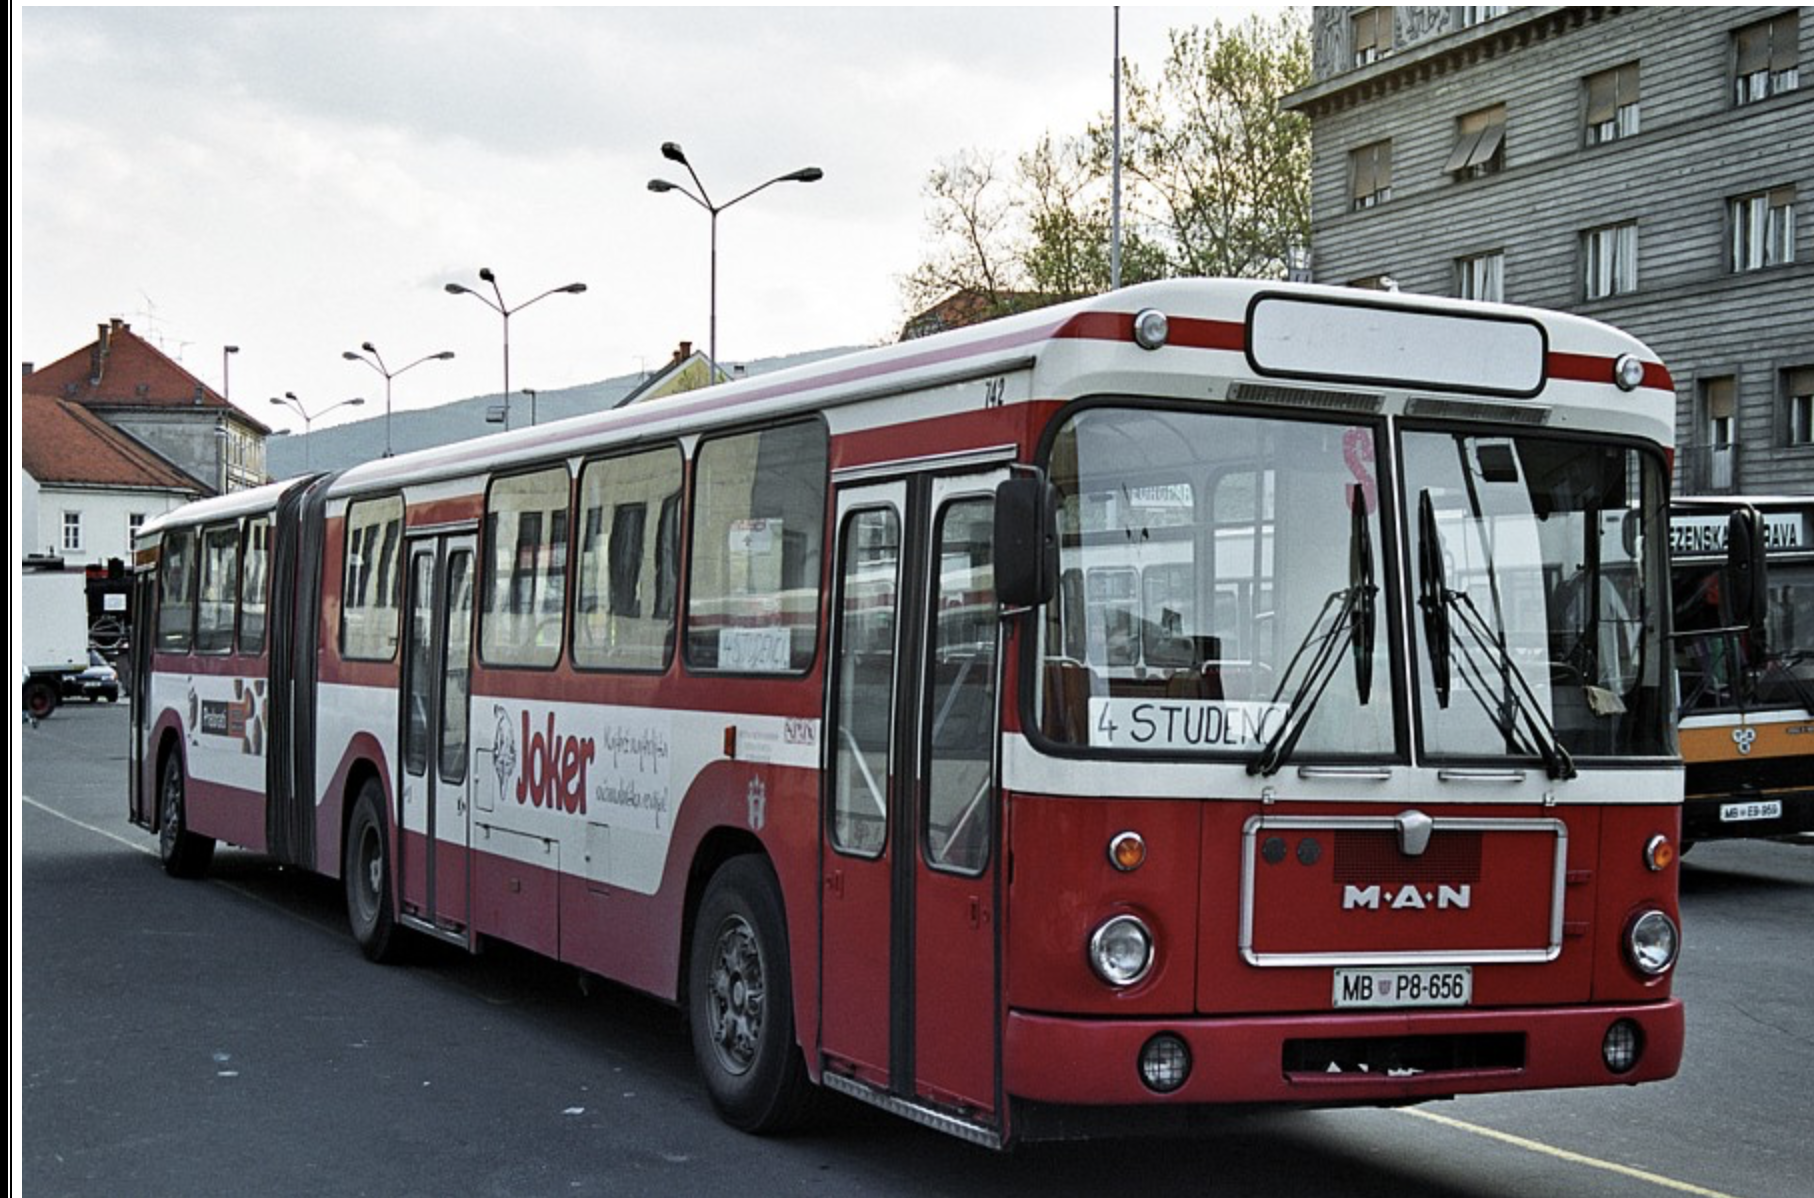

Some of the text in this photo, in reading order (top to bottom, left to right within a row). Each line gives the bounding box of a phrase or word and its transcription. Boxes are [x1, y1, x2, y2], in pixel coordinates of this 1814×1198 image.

[986, 377, 1005, 408] 742
[1098, 702, 1291, 745] 4 STUDENC
[516, 710, 595, 815] Joker
[1343, 974, 1464, 1000] MB P8-656
